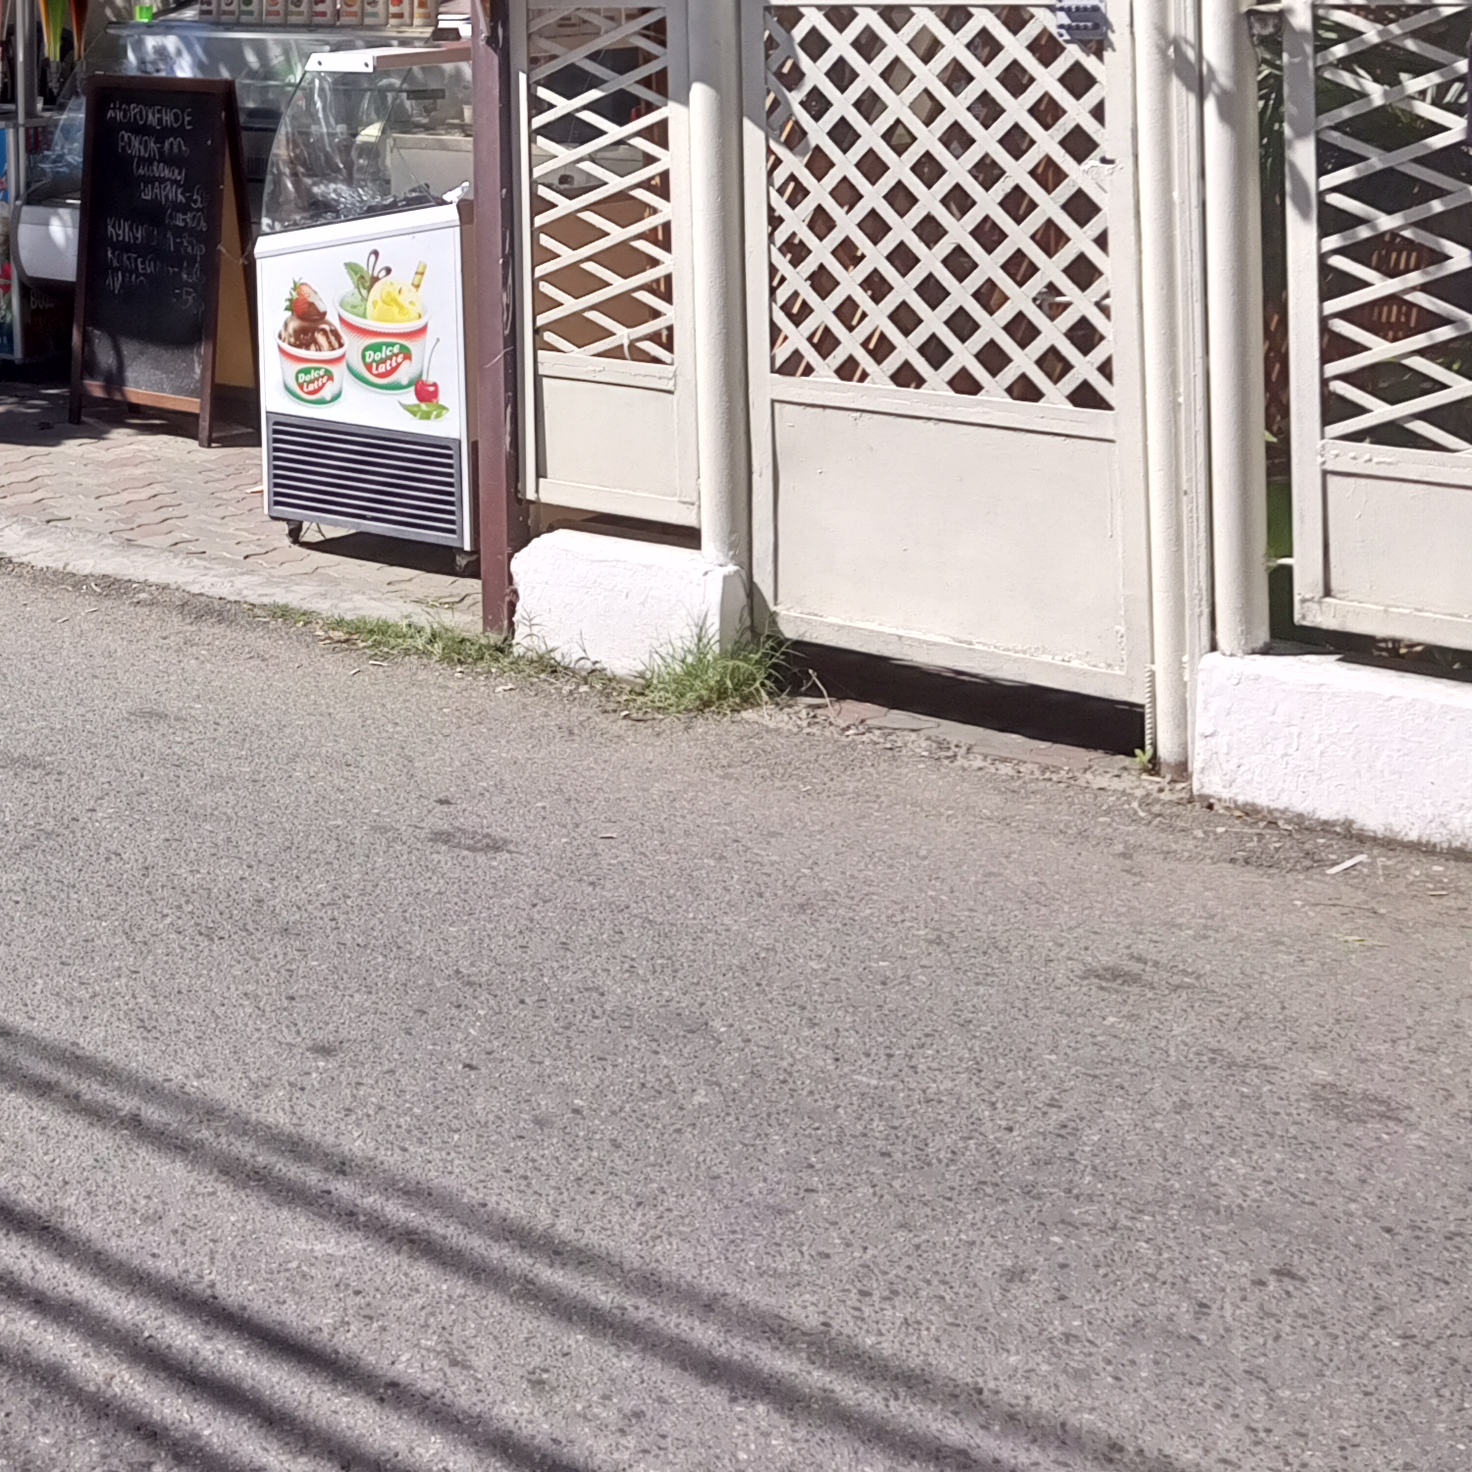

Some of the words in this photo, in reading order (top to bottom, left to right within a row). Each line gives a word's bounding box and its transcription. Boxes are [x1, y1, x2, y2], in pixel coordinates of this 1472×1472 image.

[364, 343, 401, 363] Dolce
[371, 353, 404, 375] Latte
[297, 368, 326, 383] Dolce
[303, 375, 328, 392] Latte
